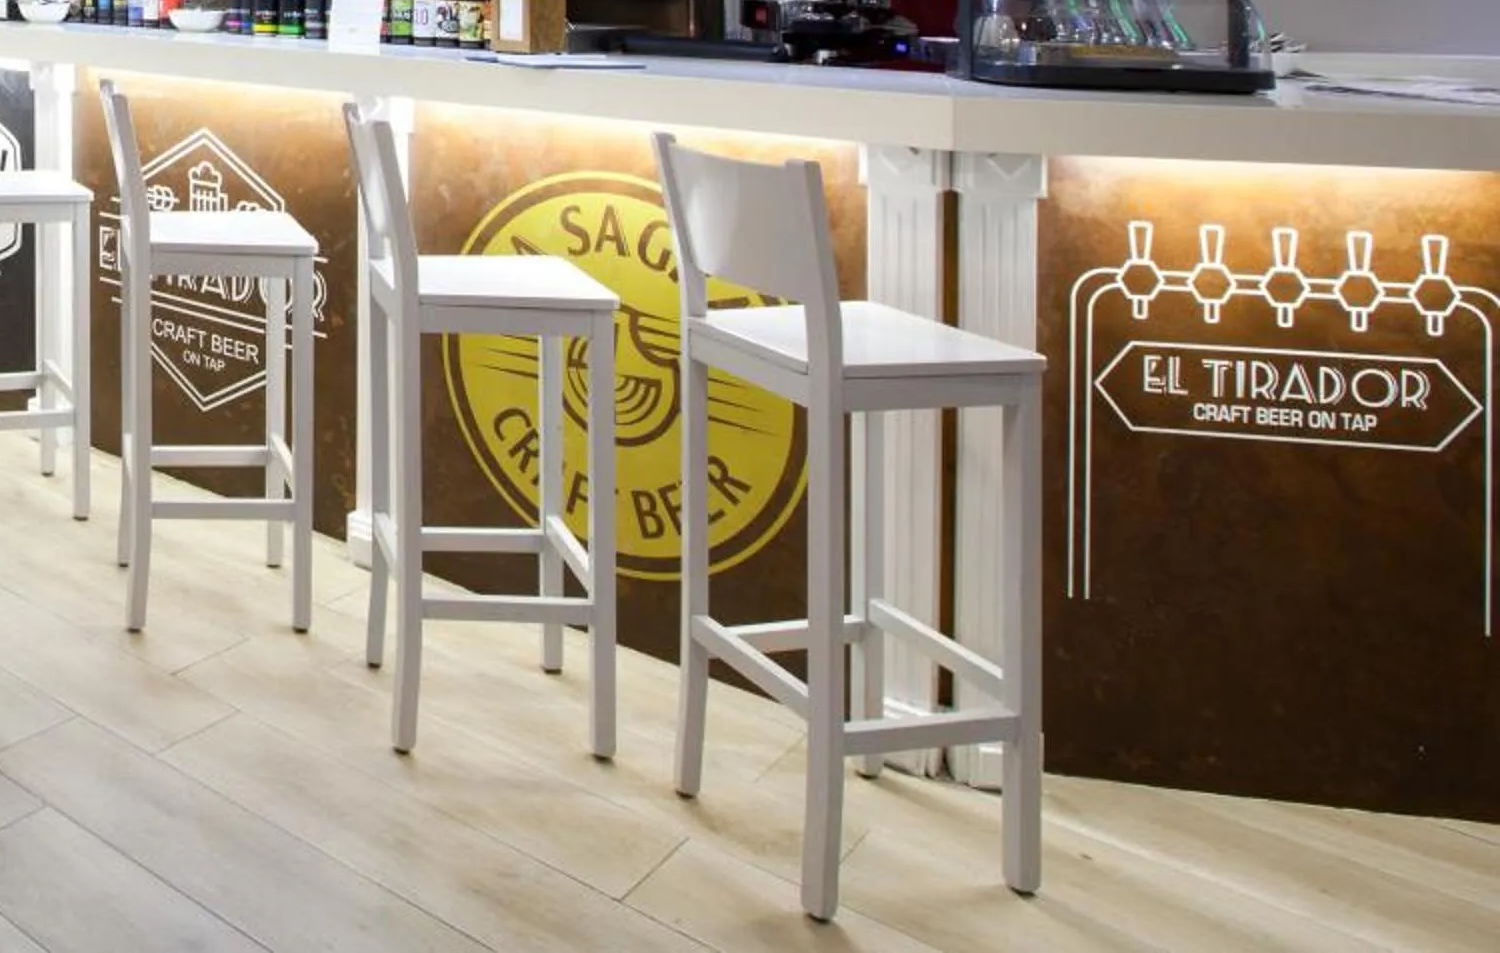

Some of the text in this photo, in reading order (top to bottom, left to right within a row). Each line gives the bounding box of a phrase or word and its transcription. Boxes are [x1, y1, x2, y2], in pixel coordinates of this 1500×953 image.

[560, 204, 679, 283] SAG
[152, 318, 259, 364] CRAFT BEER
[183, 350, 226, 372] ON TAP
[1143, 354, 1430, 411] EL TIRADOR
[1193, 402, 1378, 432] CRAFT BEER ON TAP
[494, 408, 618, 515] CRF
